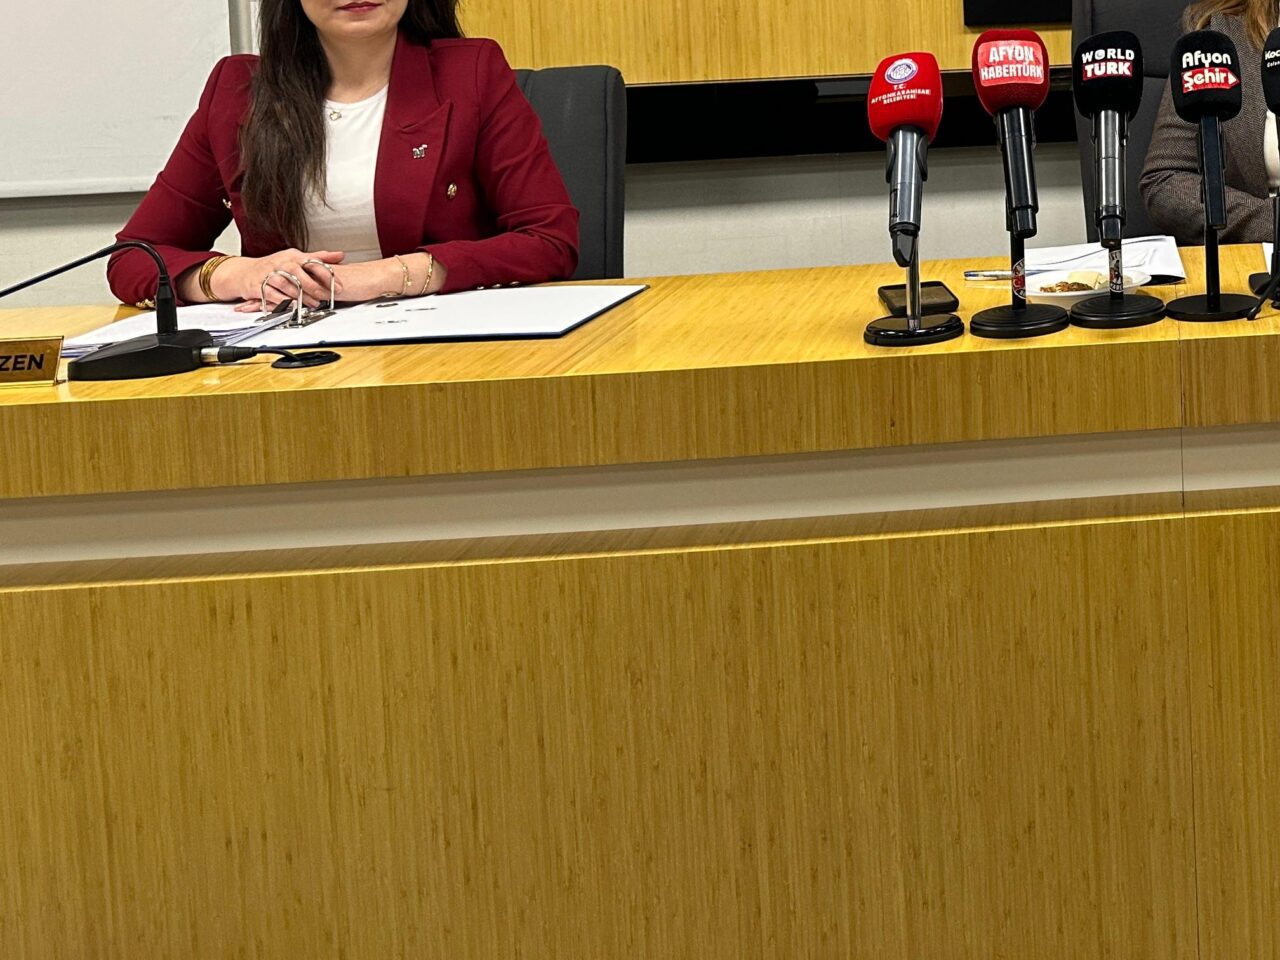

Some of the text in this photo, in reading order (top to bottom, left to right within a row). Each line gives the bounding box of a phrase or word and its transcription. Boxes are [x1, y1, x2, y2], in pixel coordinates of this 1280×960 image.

[989, 45, 1034, 63] AFYON
[1082, 48, 1135, 64] WORLD
[1182, 50, 1232, 68] Afyon
[981, 62, 1042, 80] HABERTÜRK
[1182, 68, 1227, 92] Şehir
